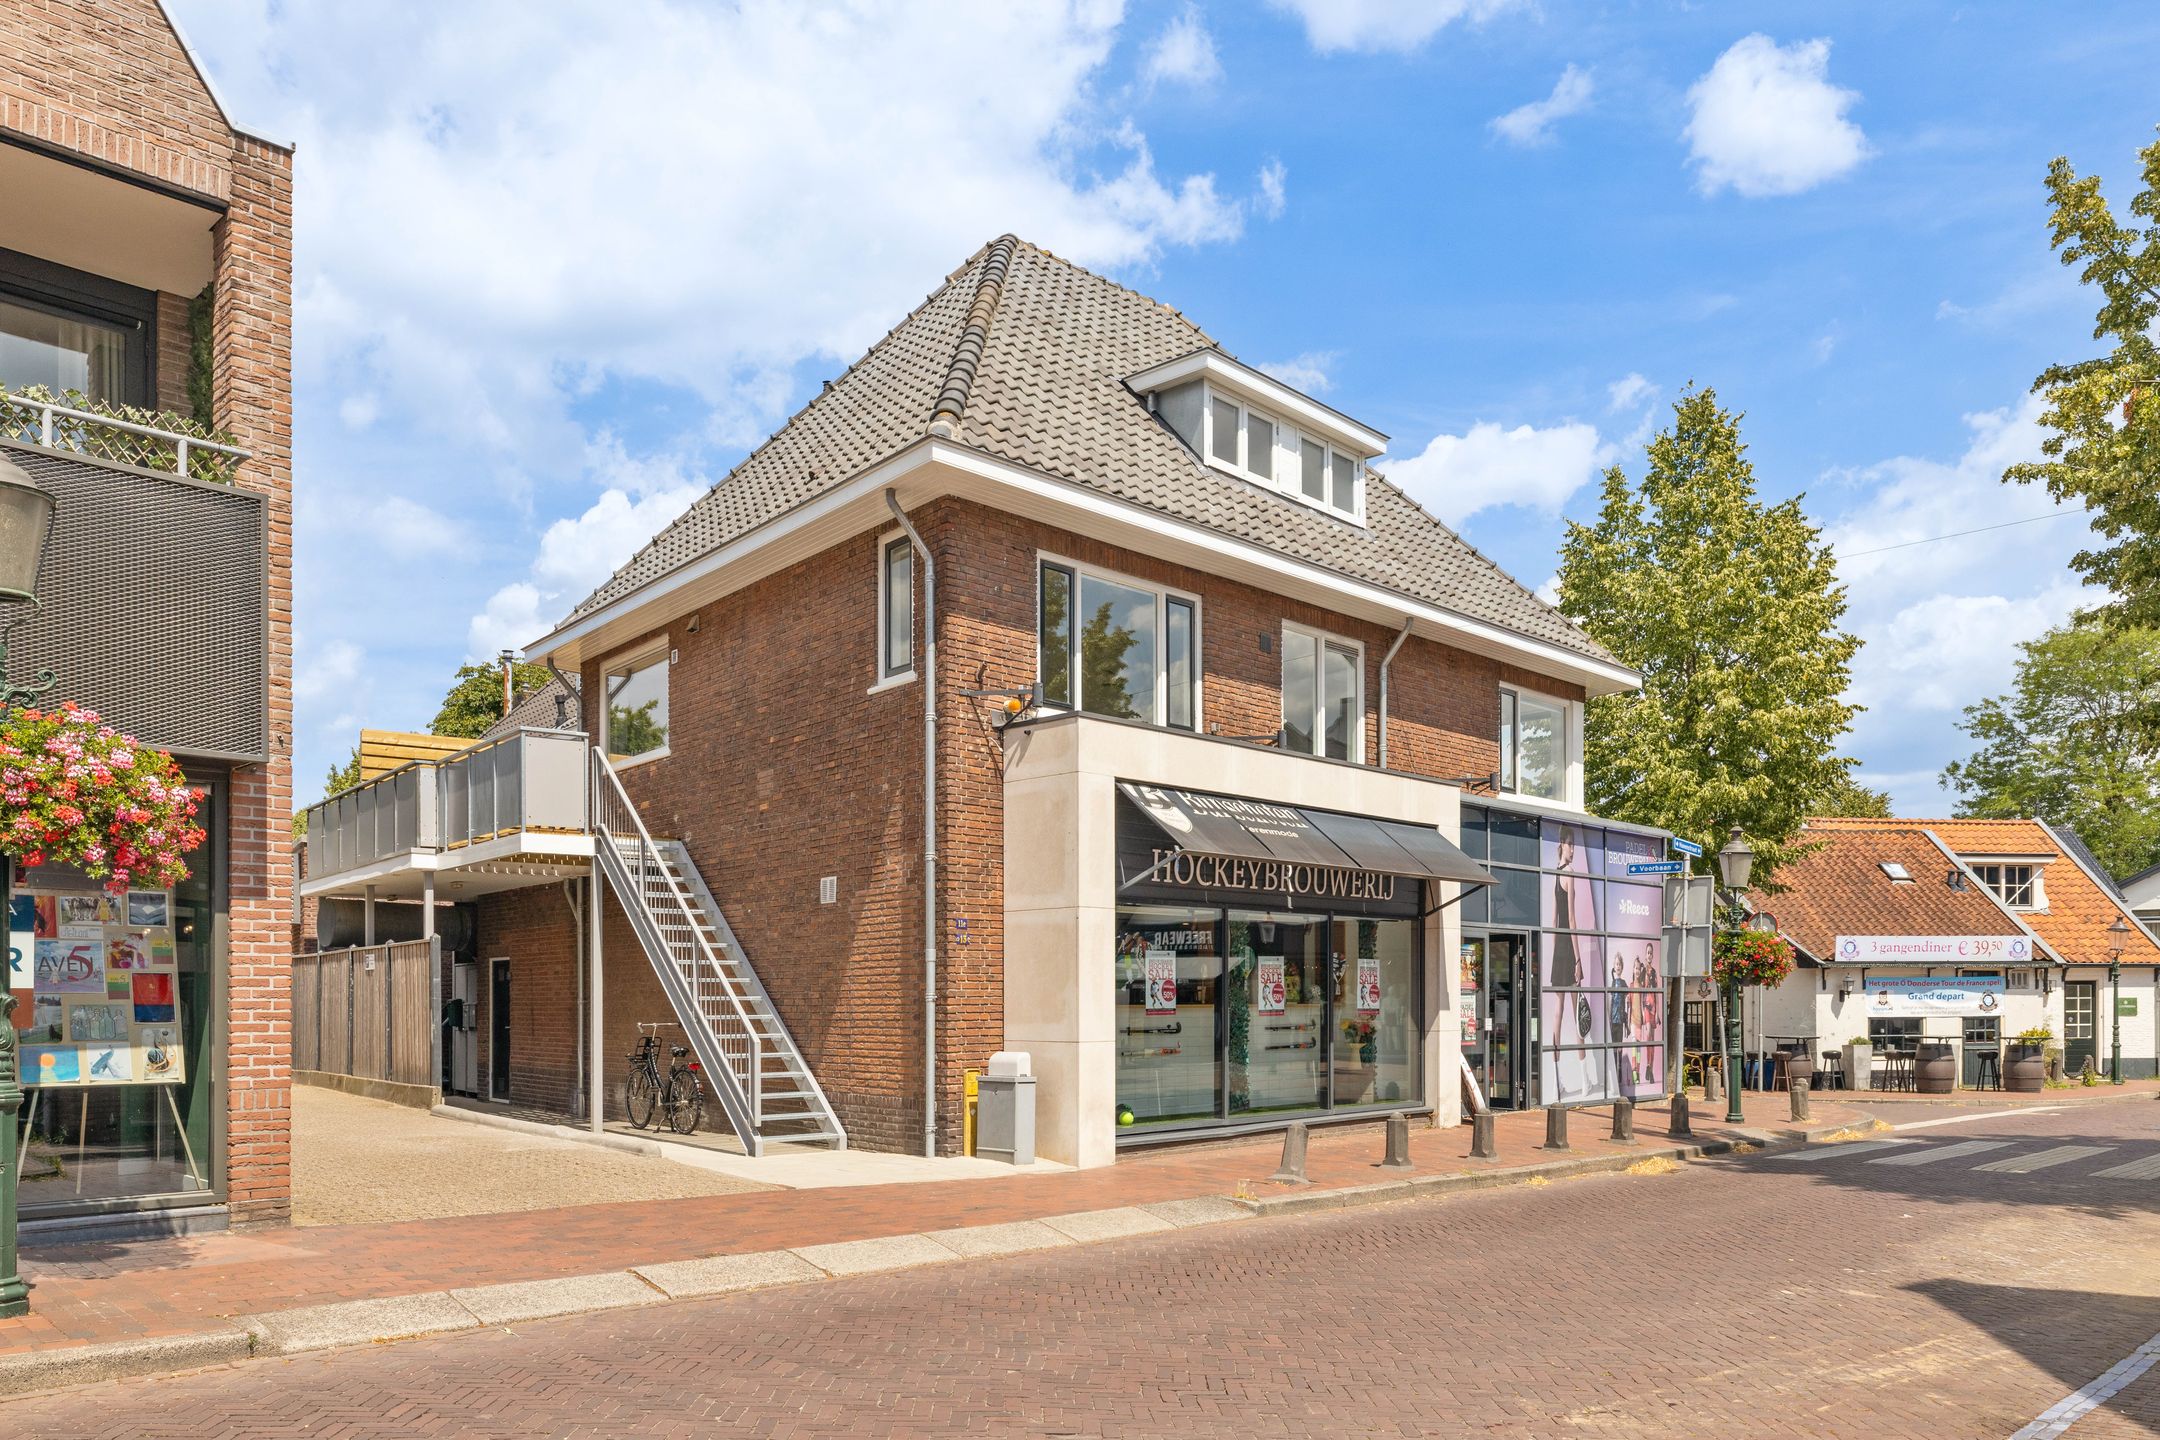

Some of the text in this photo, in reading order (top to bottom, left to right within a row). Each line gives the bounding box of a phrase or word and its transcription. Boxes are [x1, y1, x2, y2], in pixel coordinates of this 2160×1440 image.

[1626, 842, 1647, 856] PADEL
[1151, 848, 1394, 900] HOCKEYBROUWERIJ
[1627, 900, 1650, 915] Reece
[1871, 941, 1877, 952] 3
[1880, 941, 1952, 954] gangendiner
[1958, 940, 1969, 956] €
[1149, 969, 1173, 980] SALE
[1261, 973, 1282, 983] SALE
[1360, 975, 1377, 984] SALE
[1163, 991, 1174, 999] 50%
[1908, 992, 1965, 1002] Grand depart
